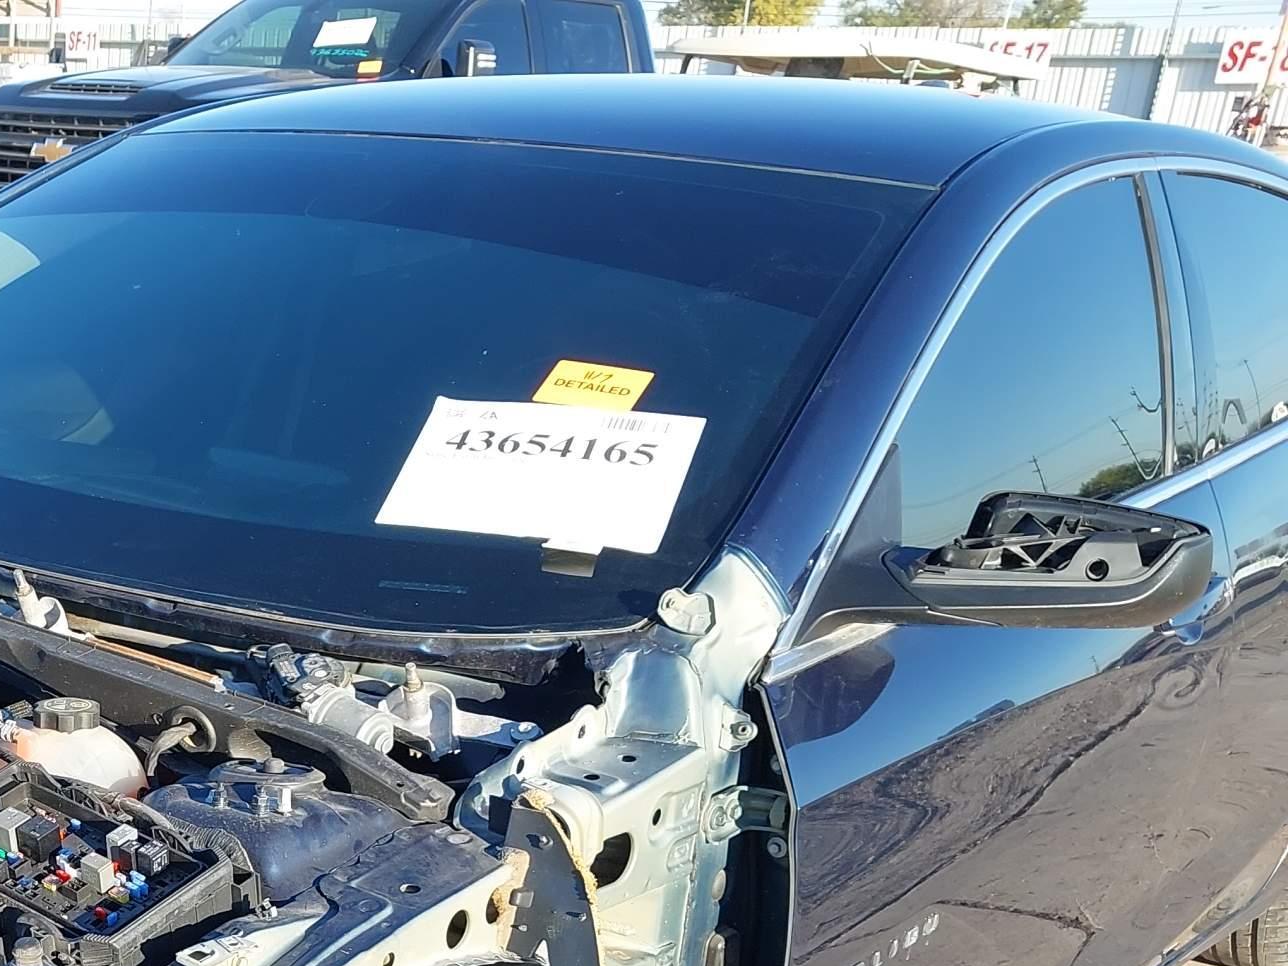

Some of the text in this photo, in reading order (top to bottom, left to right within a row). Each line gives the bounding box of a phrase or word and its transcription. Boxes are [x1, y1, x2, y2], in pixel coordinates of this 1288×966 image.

[68, 31, 97, 51] SF-11
[554, 379, 631, 396] DETAILED
[445, 429, 658, 466] 43654165
